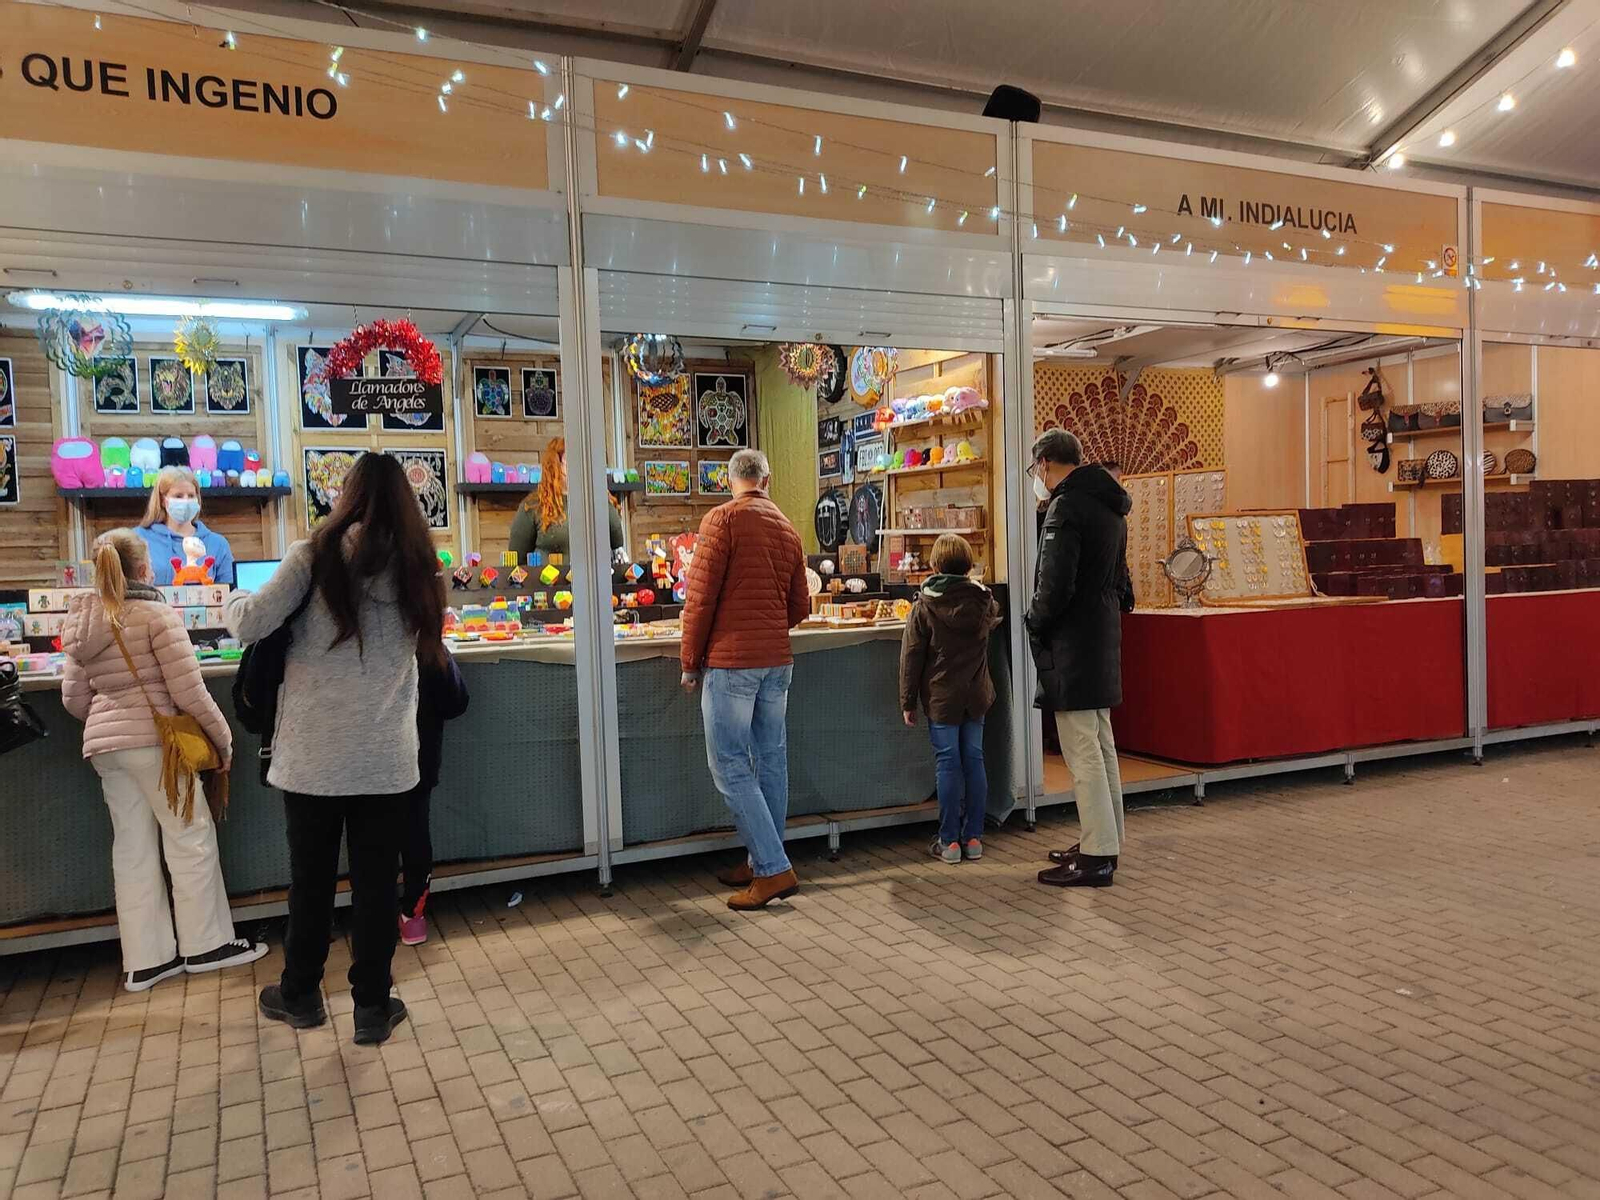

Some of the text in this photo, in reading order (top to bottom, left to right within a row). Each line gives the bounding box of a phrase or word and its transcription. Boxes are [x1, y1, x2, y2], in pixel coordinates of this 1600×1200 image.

[21, 53, 338, 120] QUE INGENIO
[1177, 194, 1193, 216] A
[1239, 200, 1358, 235] INDIALUCIA
[349, 380, 425, 395] Llamadores
[351, 393, 427, 413] de Angeles
